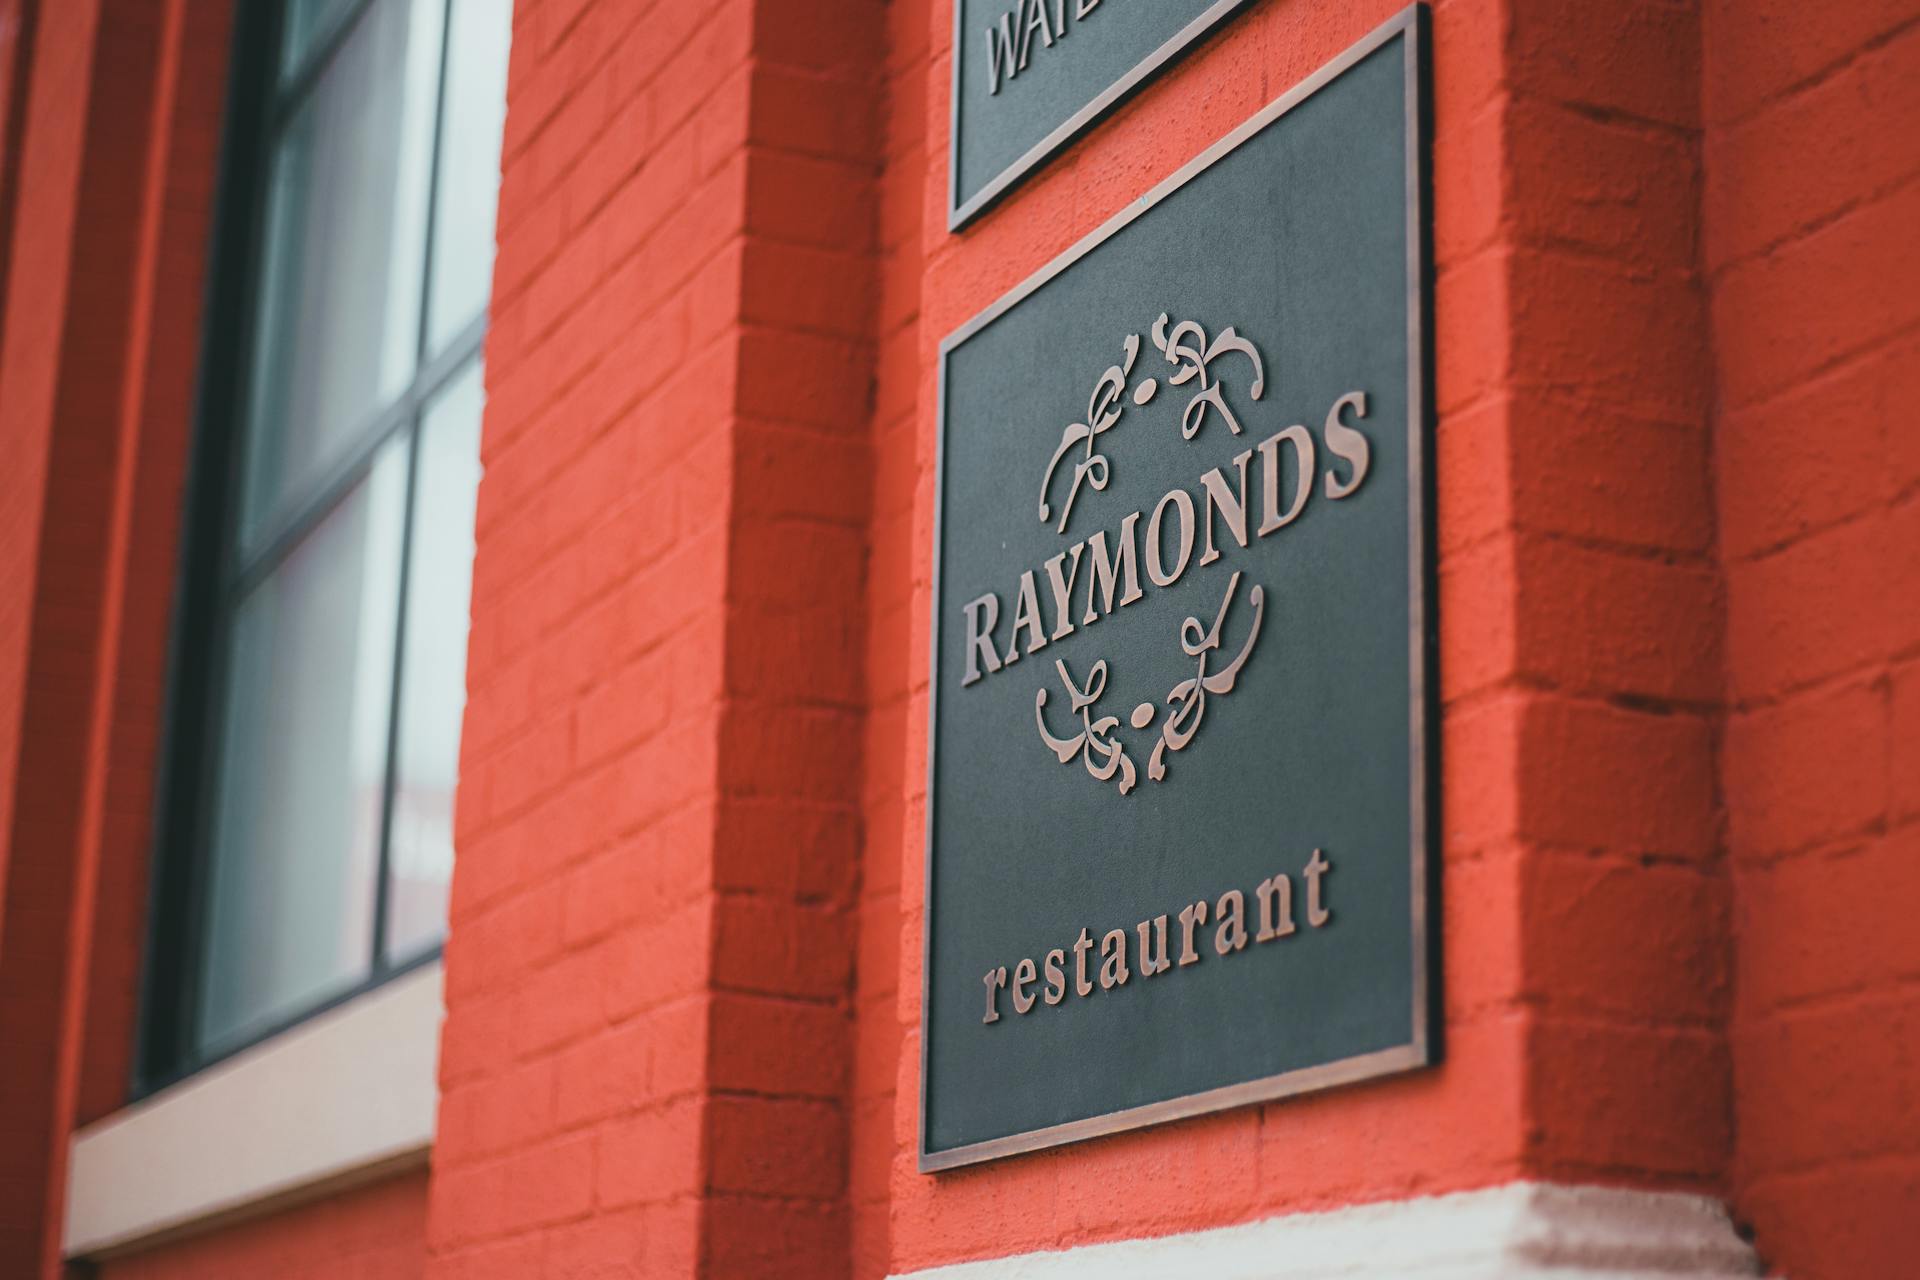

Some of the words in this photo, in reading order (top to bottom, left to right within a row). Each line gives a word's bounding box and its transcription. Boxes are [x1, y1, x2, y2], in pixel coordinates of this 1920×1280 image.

[985, 0, 1101, 96] WA
[961, 391, 1371, 687] RAYMONDS
[982, 848, 1330, 1024] restaurant
